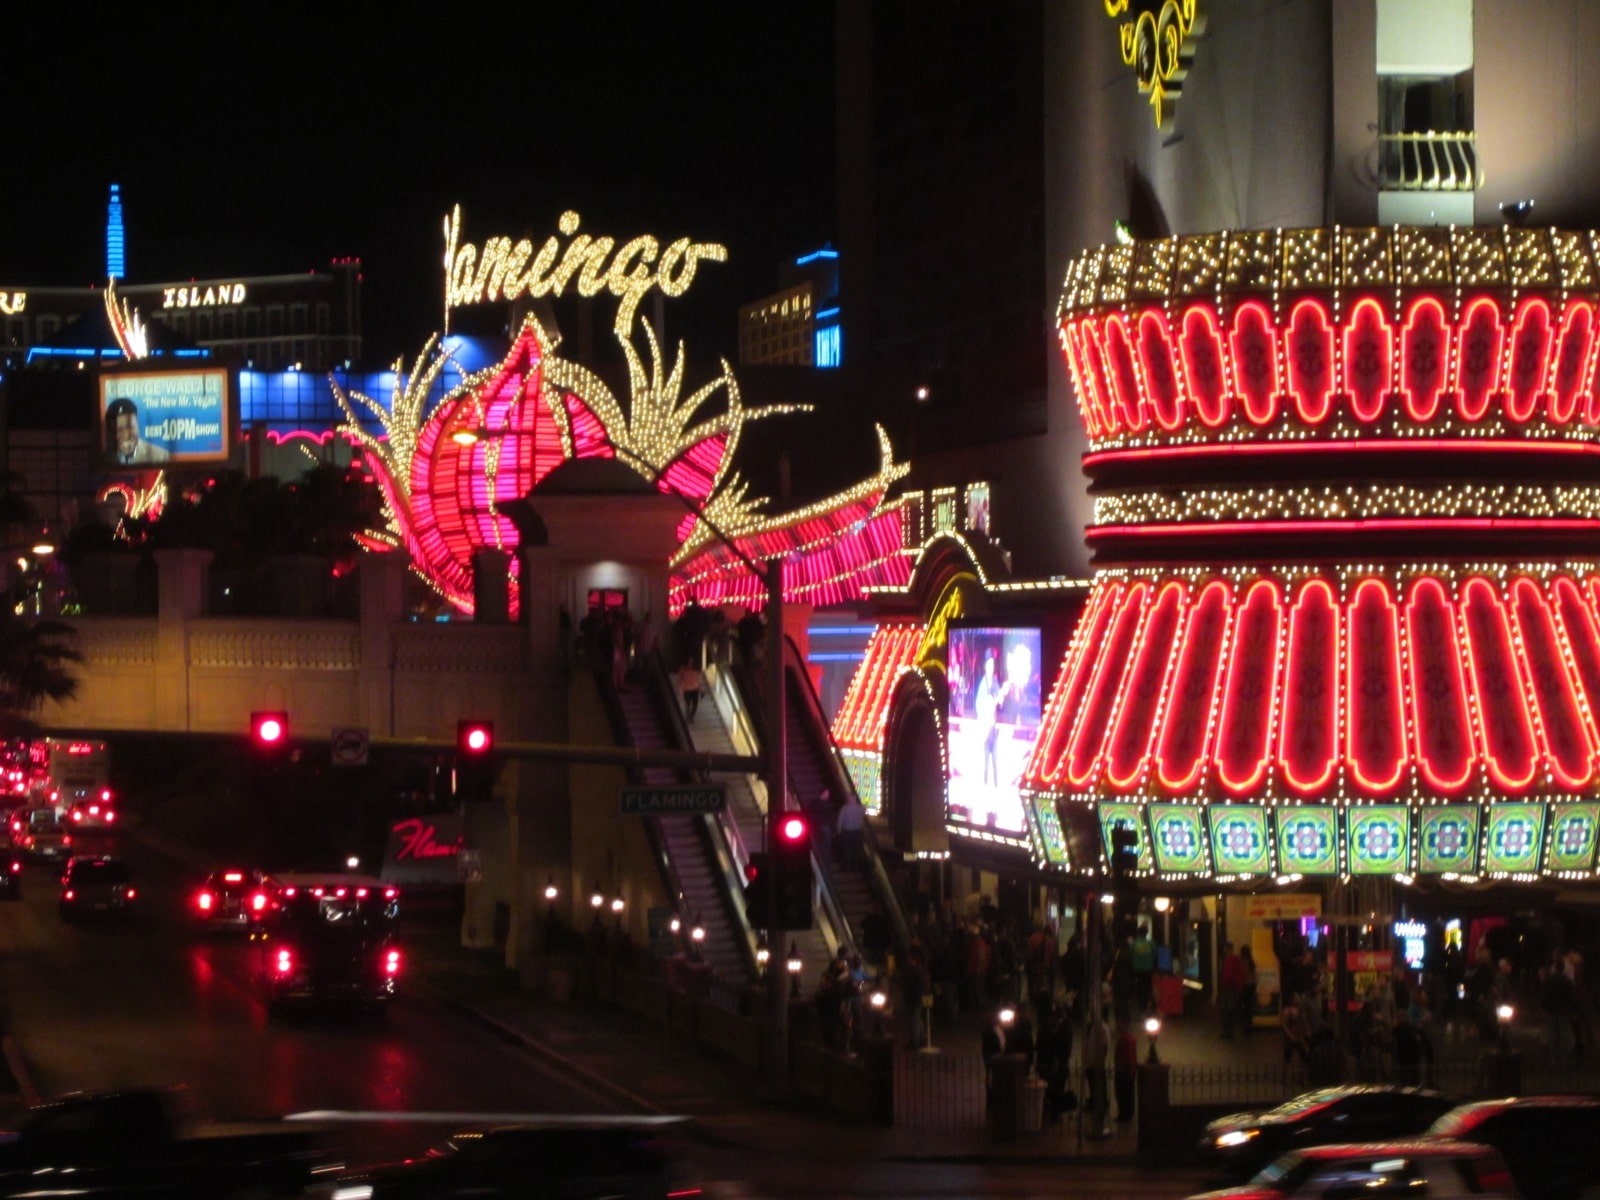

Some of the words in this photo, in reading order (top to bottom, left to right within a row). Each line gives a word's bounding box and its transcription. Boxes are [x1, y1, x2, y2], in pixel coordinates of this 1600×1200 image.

[443, 203, 728, 338] lamingo
[163, 284, 246, 309] ISLAND
[162, 418, 196, 441] 10PM
[626, 792, 721, 809] FLAMINGO
